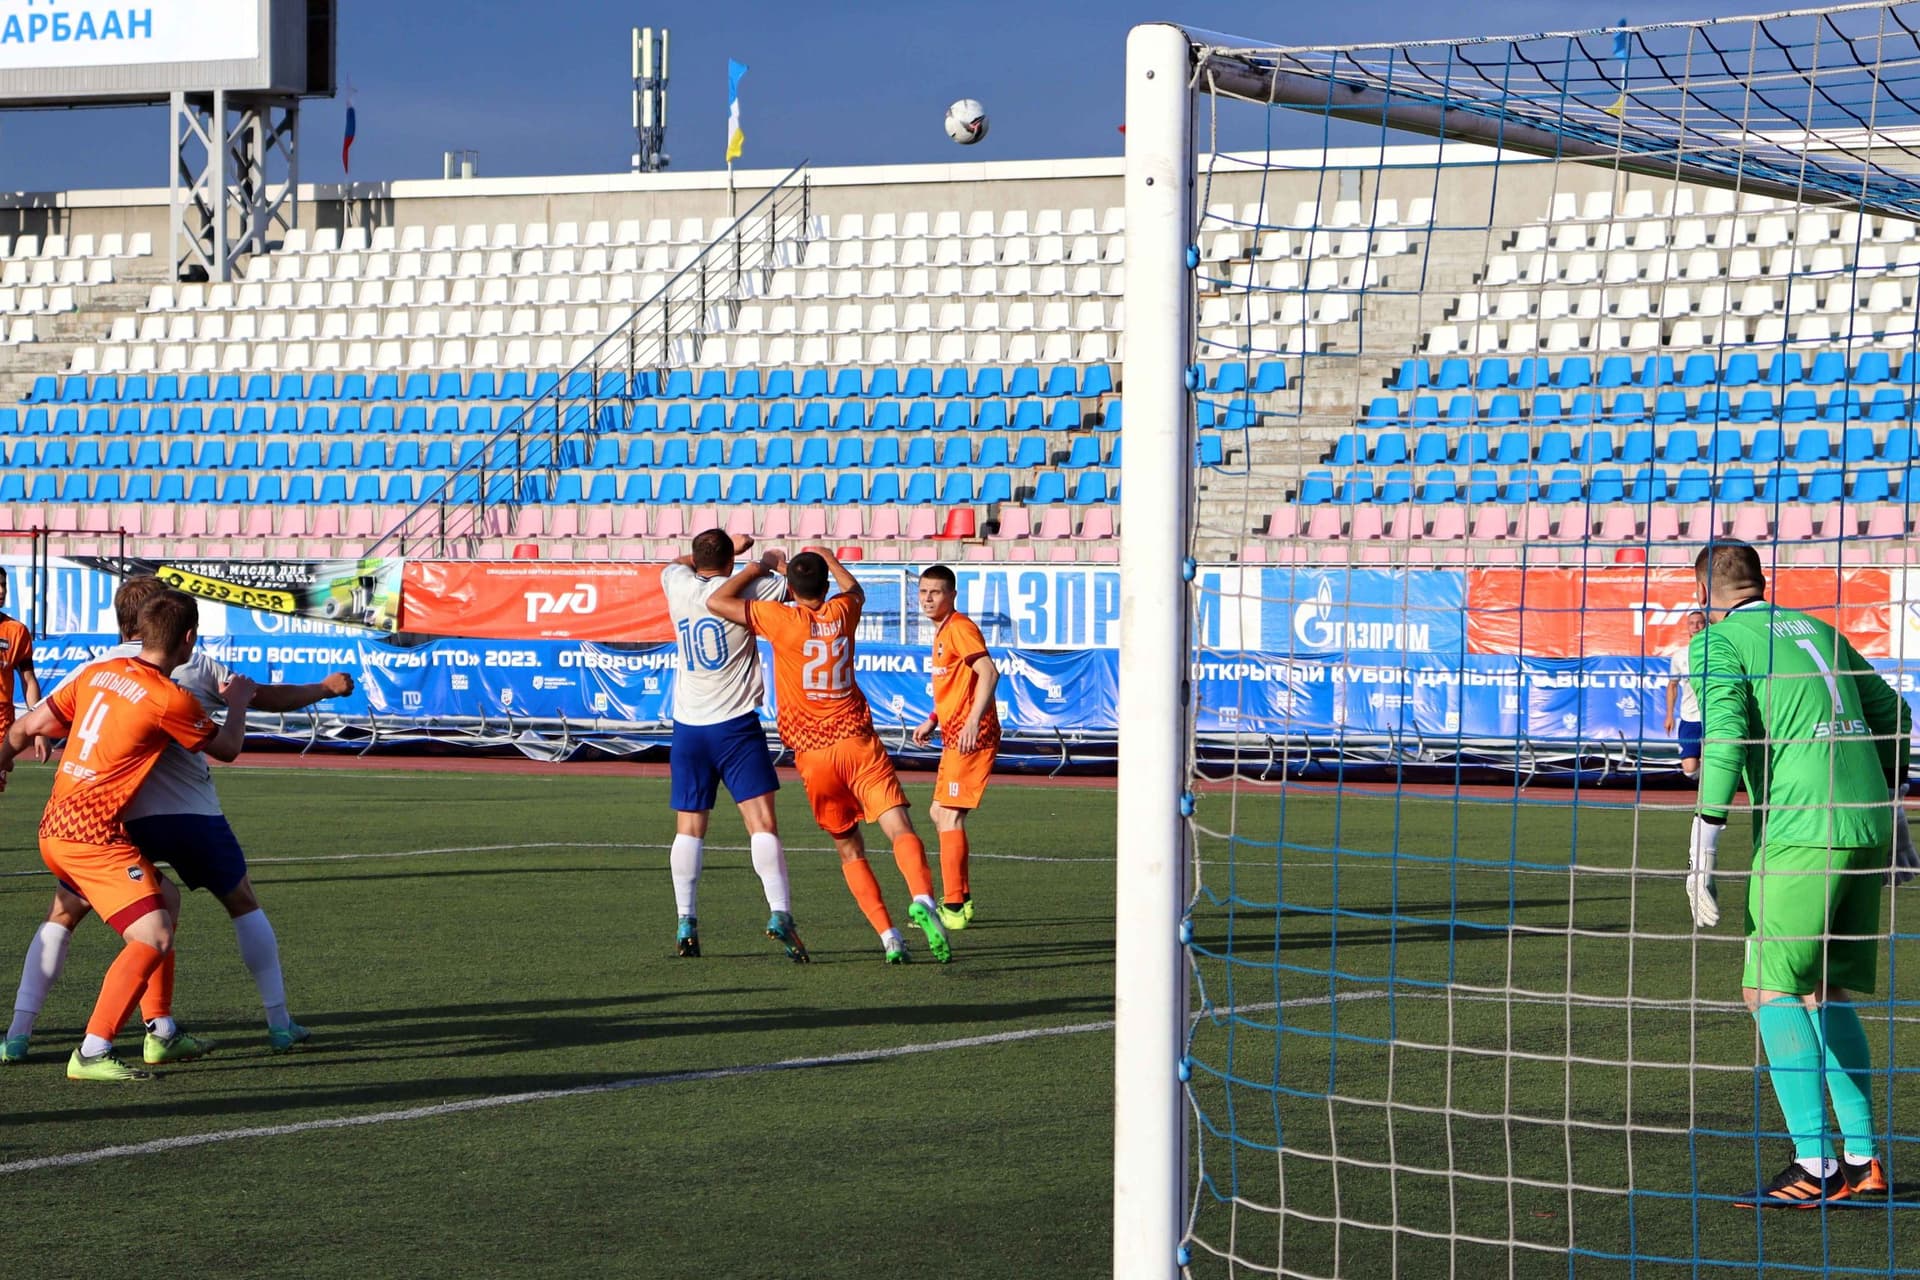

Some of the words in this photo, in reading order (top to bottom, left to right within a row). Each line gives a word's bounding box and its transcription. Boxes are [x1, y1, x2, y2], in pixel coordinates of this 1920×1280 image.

[229, 564, 276, 576] МАСЛА
[279, 564, 307, 577] ДЛЯ
[678, 617, 728, 672] 10
[1334, 621, 1430, 649] ГАЗПРОМ
[267, 647, 356, 665] ВОСТОКА
[431, 650, 481, 667] ГТО»
[484, 650, 542, 667] 2023.
[802, 635, 852, 690] 22
[1191, 663, 1325, 682] ОТКРЫТЫЙ
[1331, 667, 1411, 685] КУБОК
[1794, 639, 1845, 714] 1
[77, 691, 110, 762] 4
[948, 781, 960, 797] 19
